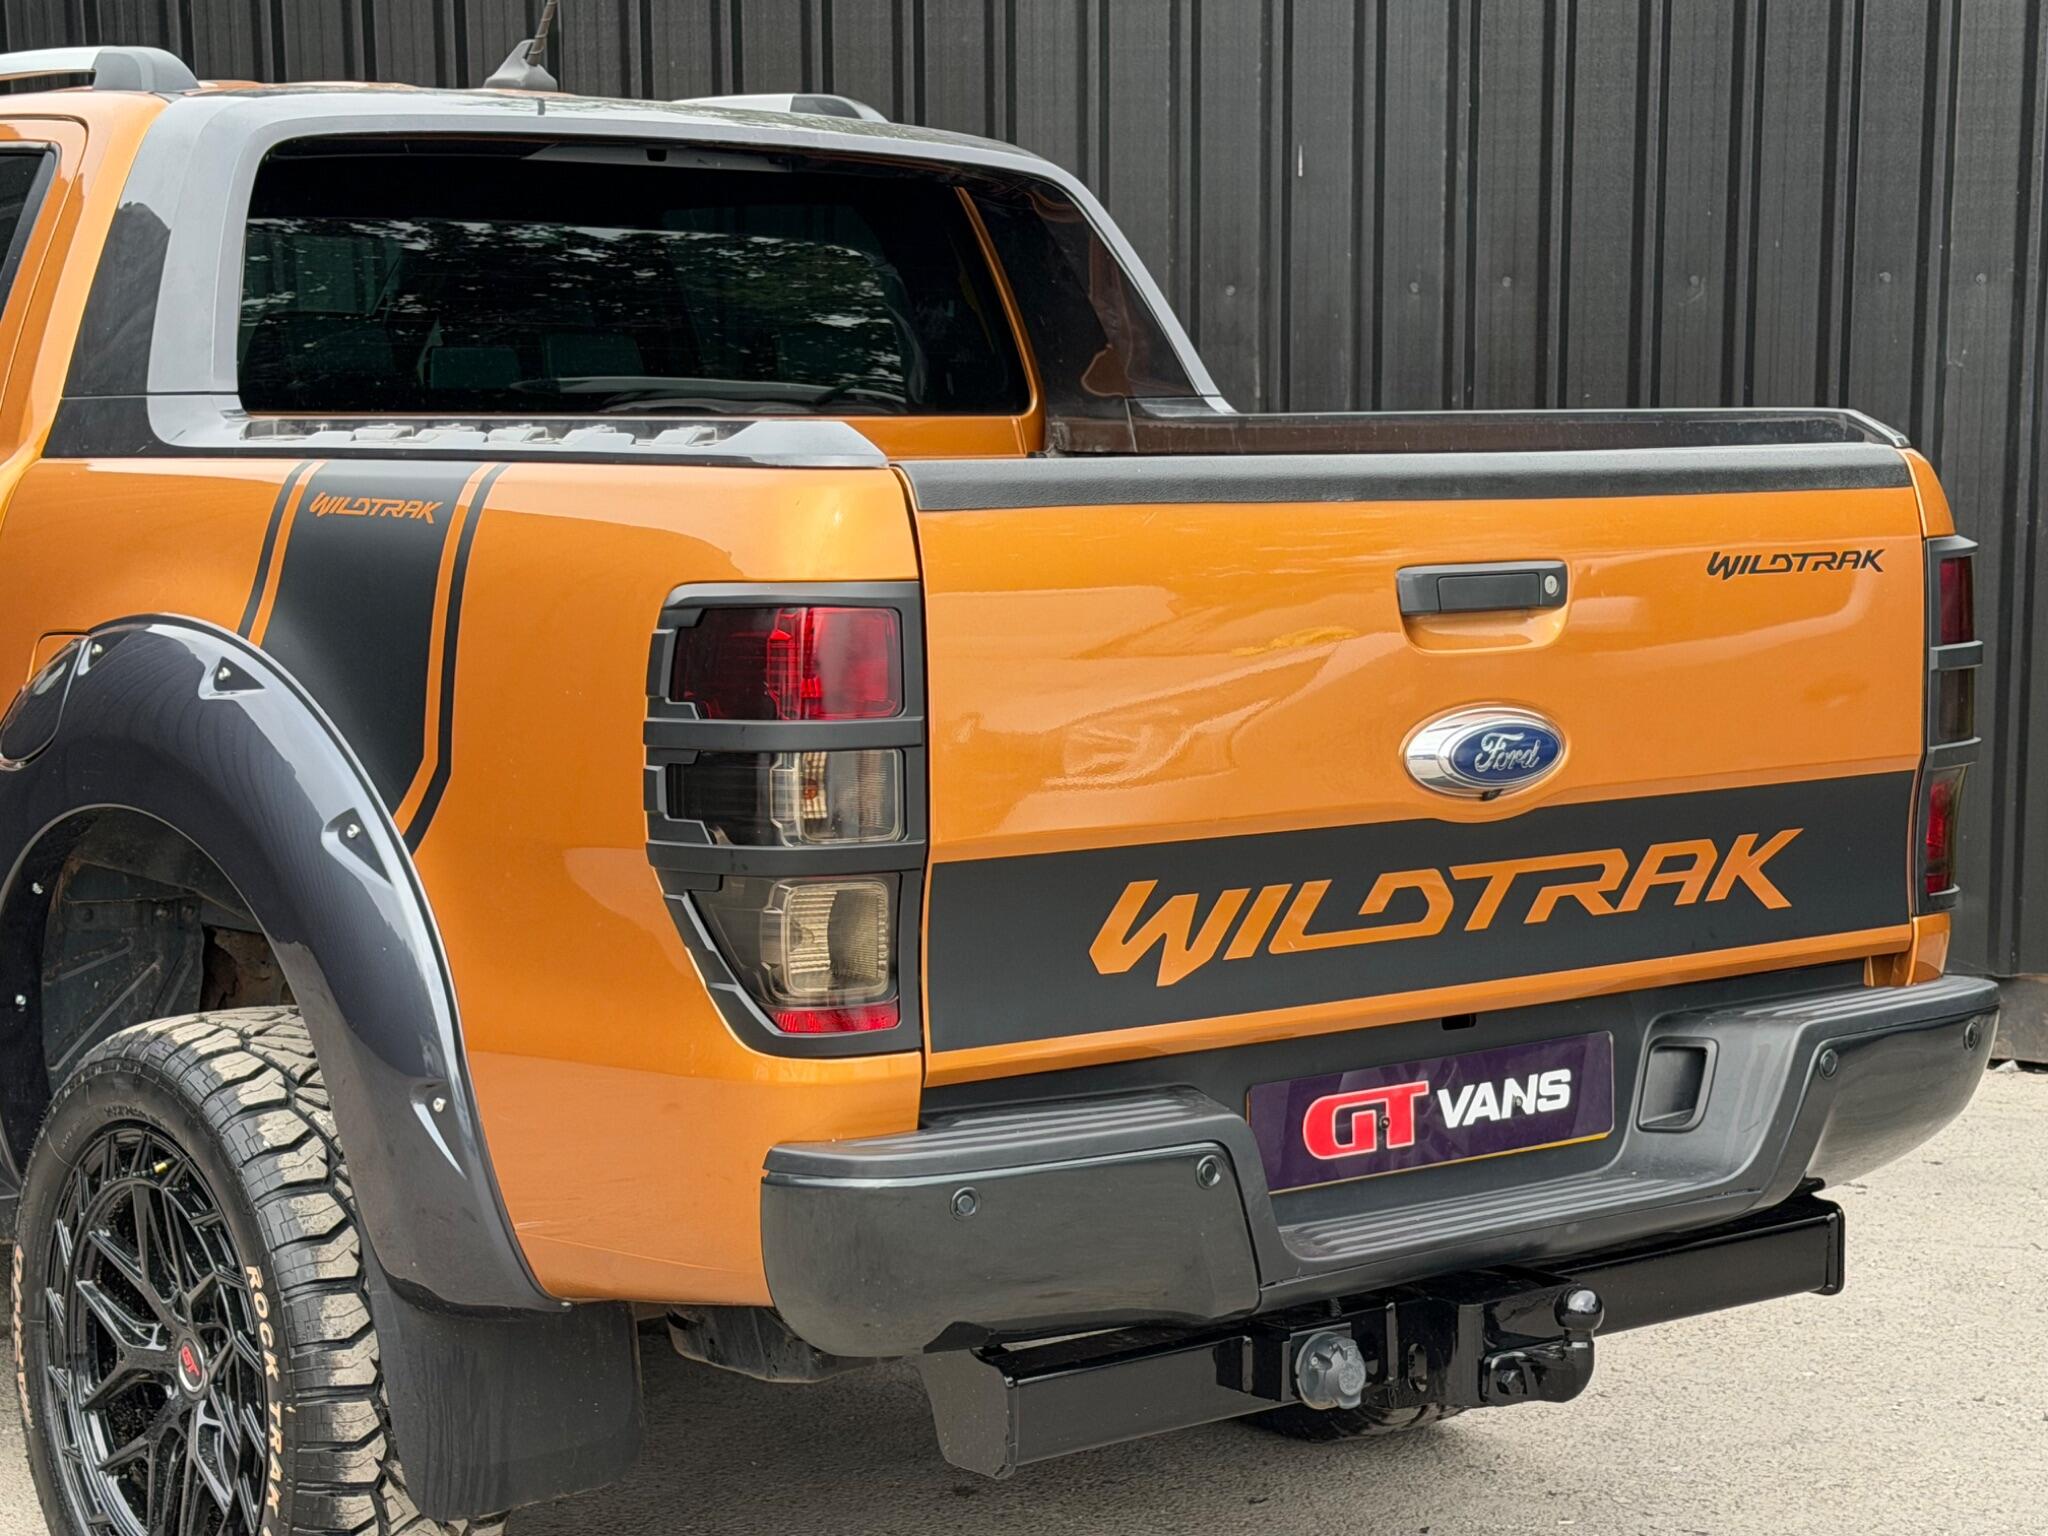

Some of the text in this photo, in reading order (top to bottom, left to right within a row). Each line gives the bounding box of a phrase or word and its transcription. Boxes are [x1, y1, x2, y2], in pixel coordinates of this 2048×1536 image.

[309, 492, 443, 524] WILDTRAK
[1707, 549, 1886, 581] WILDTRAK
[1474, 732, 1541, 773] Ford
[1089, 828, 1804, 987] WILDTRAK
[1302, 1068, 1571, 1161] GT VANS
[246, 1266, 280, 1382] ROCK
